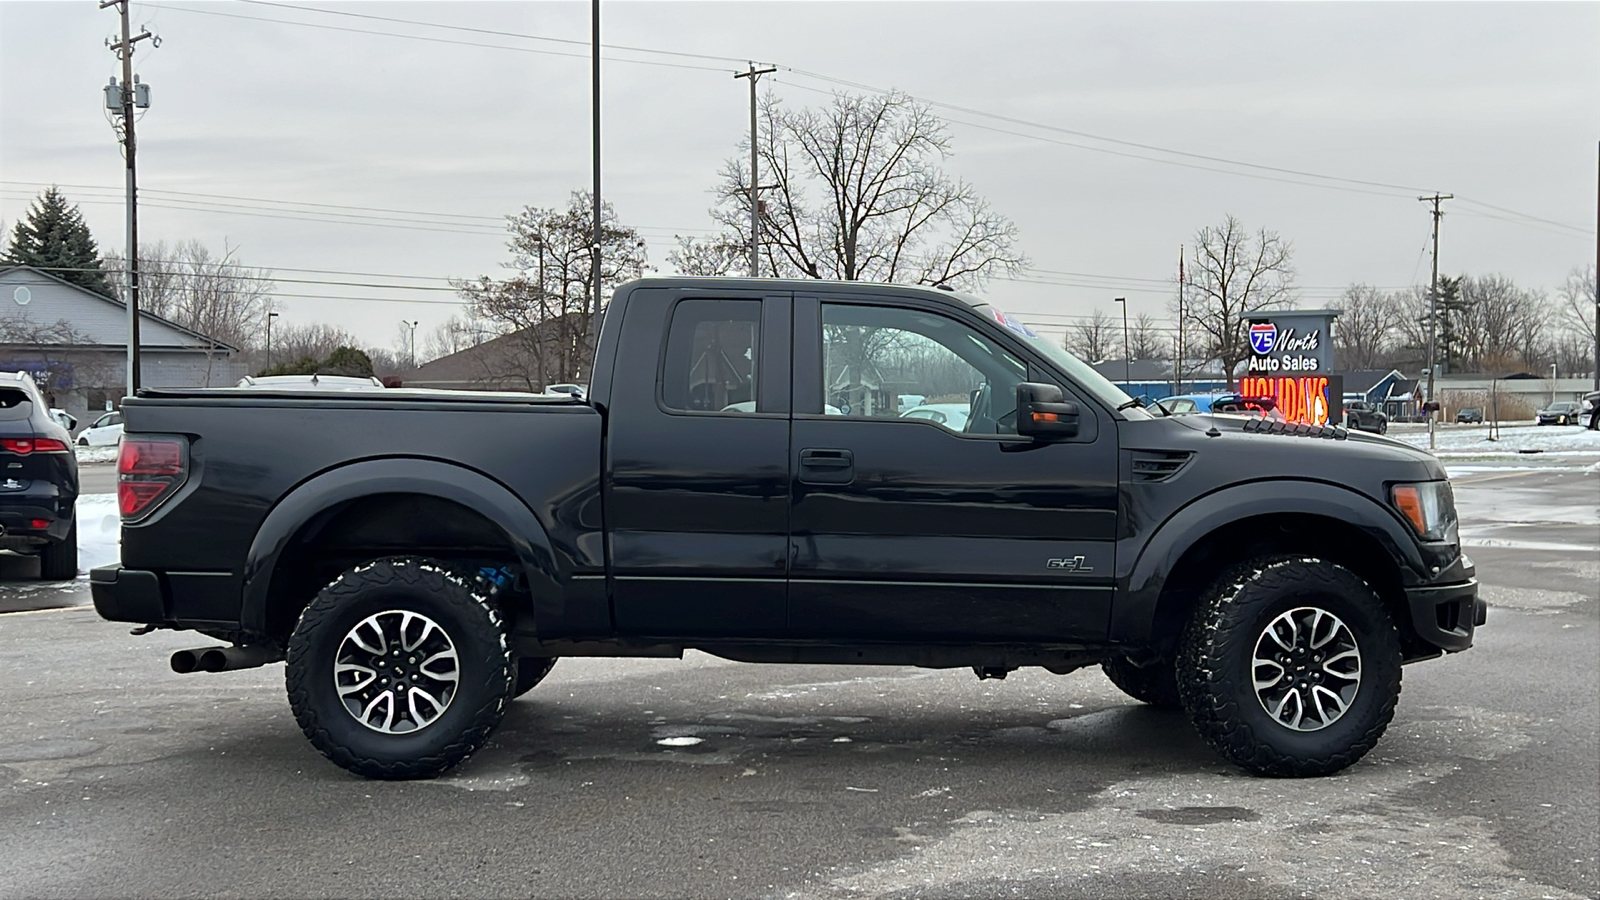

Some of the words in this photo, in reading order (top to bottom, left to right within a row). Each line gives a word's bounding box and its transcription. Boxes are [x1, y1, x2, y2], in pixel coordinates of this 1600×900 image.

[1254, 333, 1273, 347] 75
[1274, 328, 1319, 352] North
[1248, 355, 1280, 371] Auto
[1282, 355, 1318, 371] Sales
